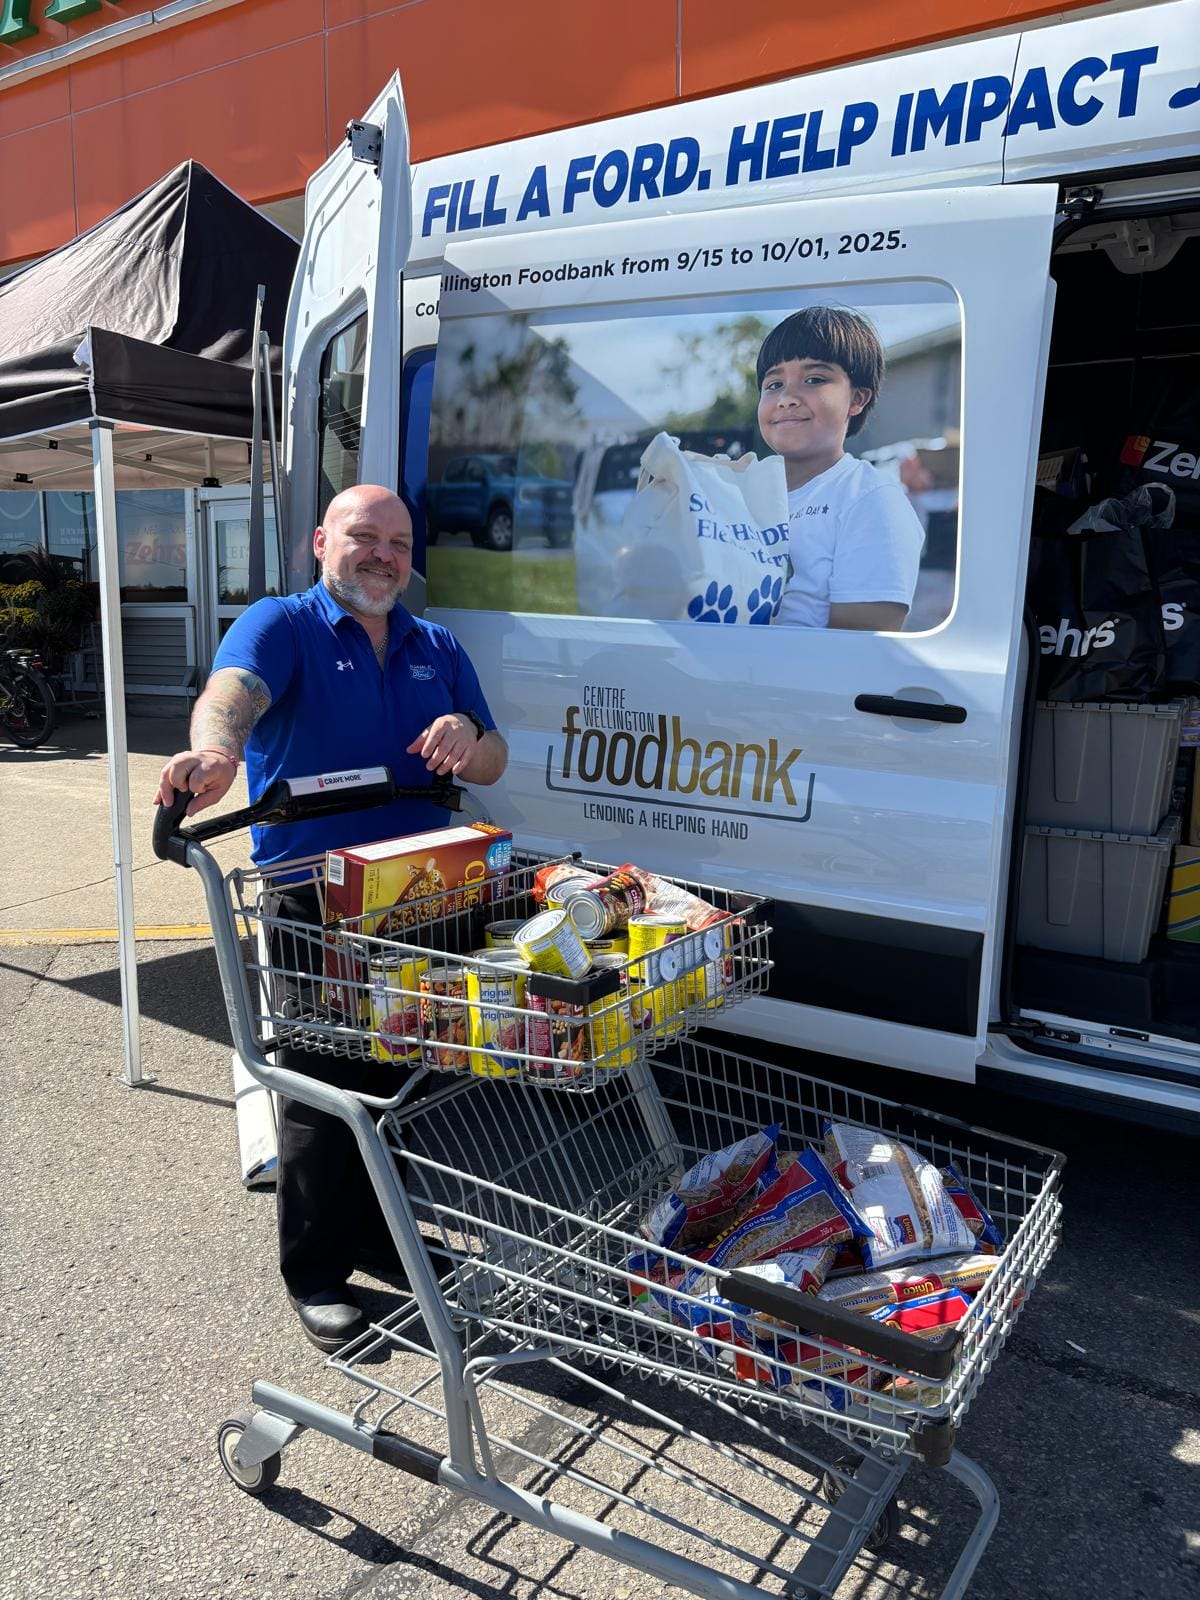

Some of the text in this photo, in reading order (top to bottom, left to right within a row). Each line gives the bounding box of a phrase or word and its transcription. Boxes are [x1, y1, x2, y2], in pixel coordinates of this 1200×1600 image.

[421, 46, 1159, 238] FILL A FORD. HELP IMPACT
[440, 229, 907, 293] llington Foodbank from 9/15 to 10/01, 2025.
[1038, 618, 1116, 658] ehrs
[583, 685, 626, 710] CENTRE
[583, 706, 655, 733] WELLINGTON
[561, 705, 803, 806] foodbank
[324, 773, 361, 785] CRAVE MORE
[583, 802, 748, 841] LENDING A HELPING HAND
[742, 1213, 777, 1232] Coudes
[902, 1216, 913, 1241] Unico
[903, 1280, 935, 1297] Unico
